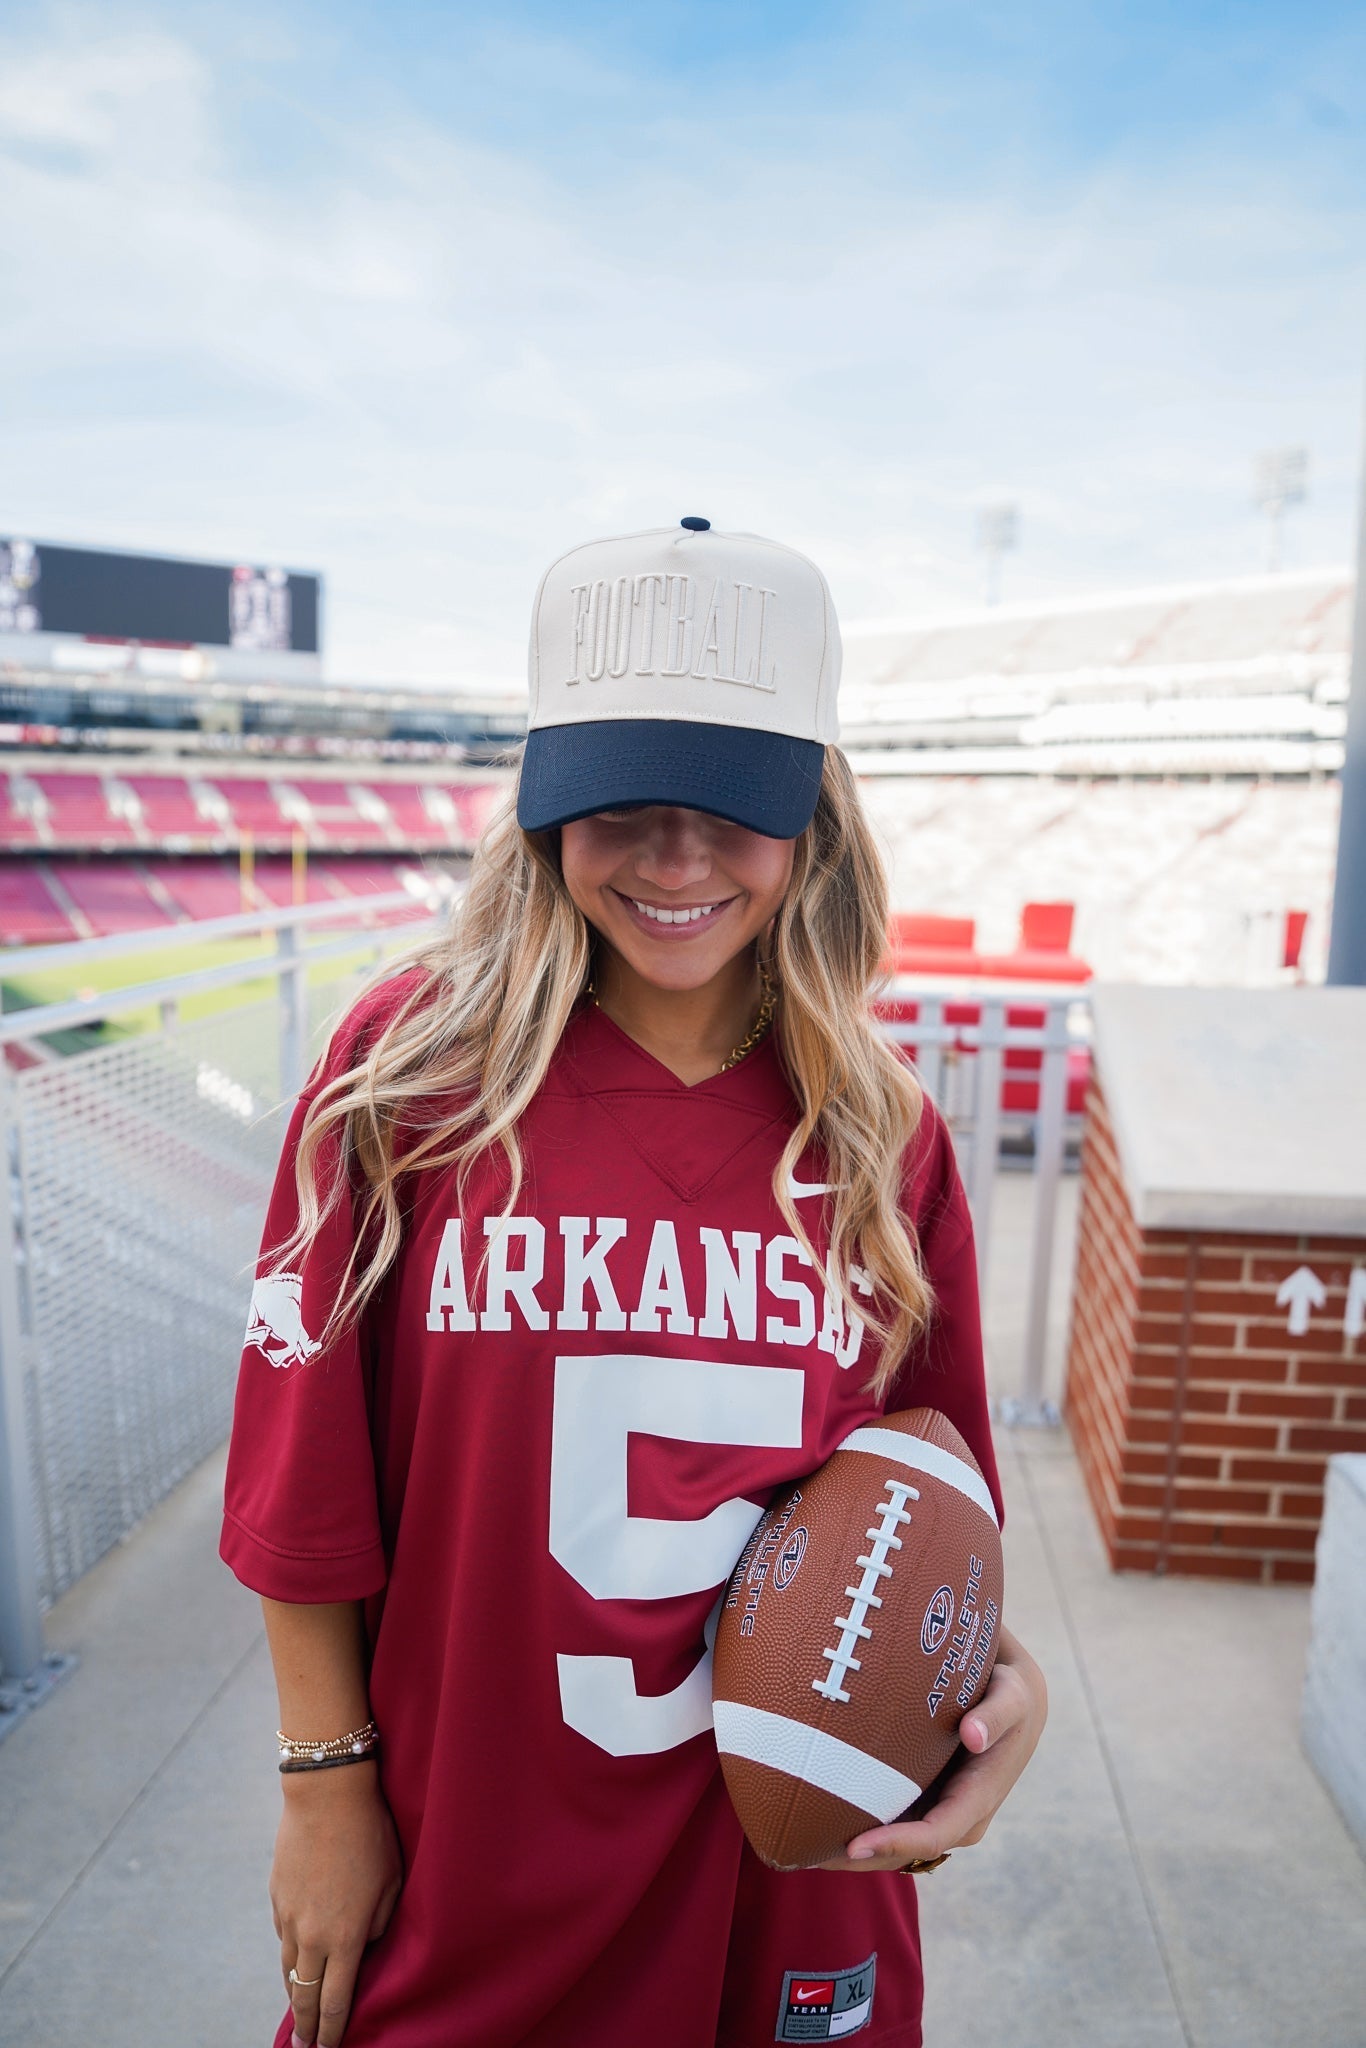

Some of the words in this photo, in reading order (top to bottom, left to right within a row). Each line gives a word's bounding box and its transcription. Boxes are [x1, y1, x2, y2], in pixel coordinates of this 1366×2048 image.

[566, 573, 777, 693] FOOTBALL
[549, 1354, 805, 1757] 5
[740, 1490, 803, 1636] ATHLETIC
[927, 1554, 983, 1718] ATHLETIC
[956, 1597, 998, 1708] SCRAMBLE
[793, 2006, 828, 2014] TEAM
[846, 1979, 866, 2004] XL
